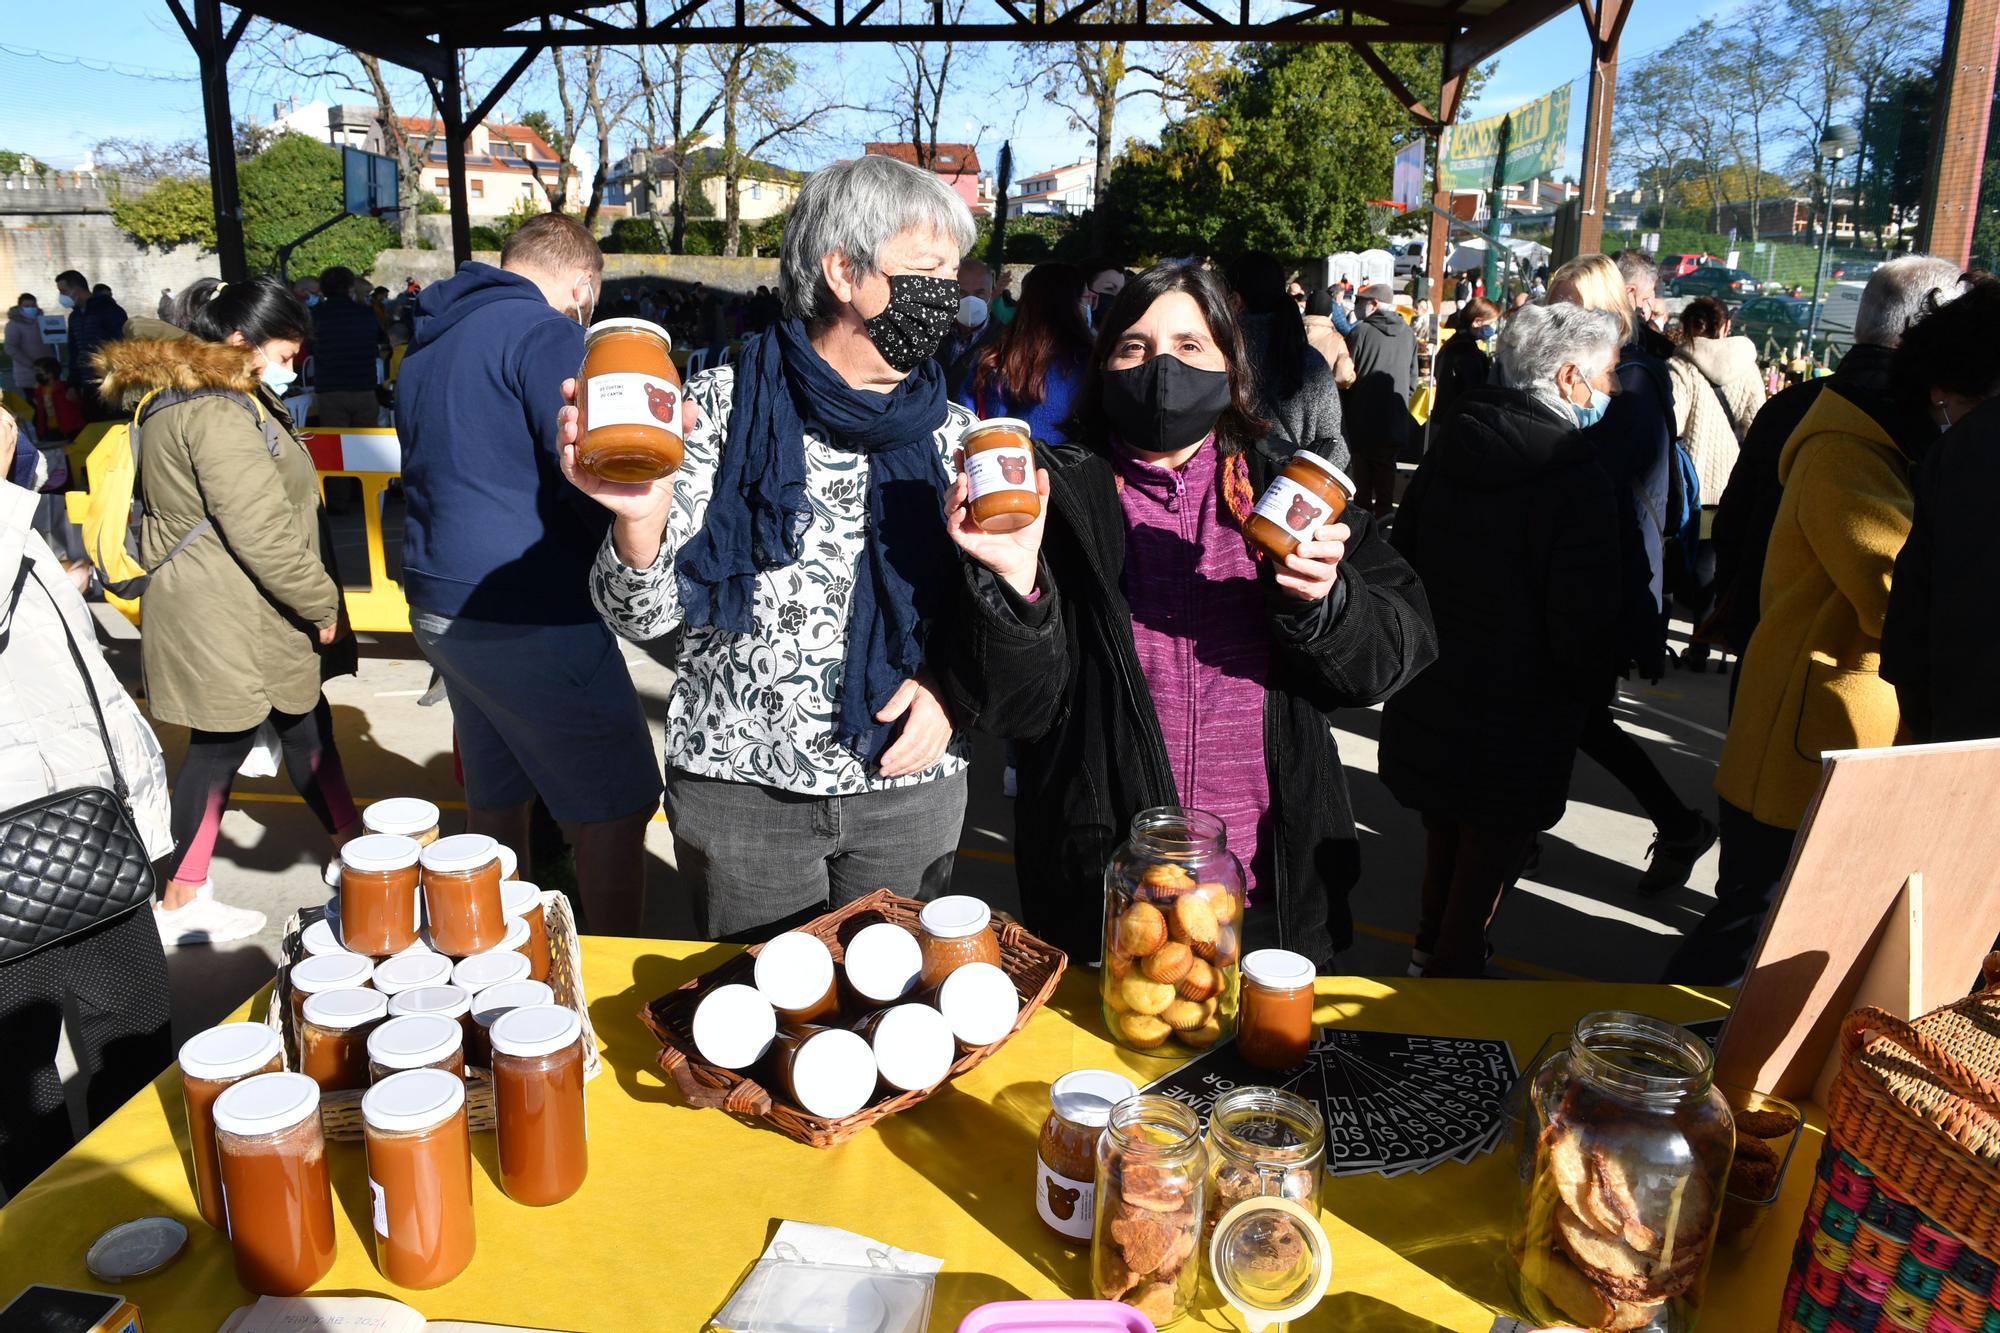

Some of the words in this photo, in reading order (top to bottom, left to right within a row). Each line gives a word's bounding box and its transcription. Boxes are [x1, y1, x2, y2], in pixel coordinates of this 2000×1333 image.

[1162, 1085, 1214, 1119] UME
[1332, 1127, 1365, 1141] SU
[1333, 1142, 1371, 1158] CO
